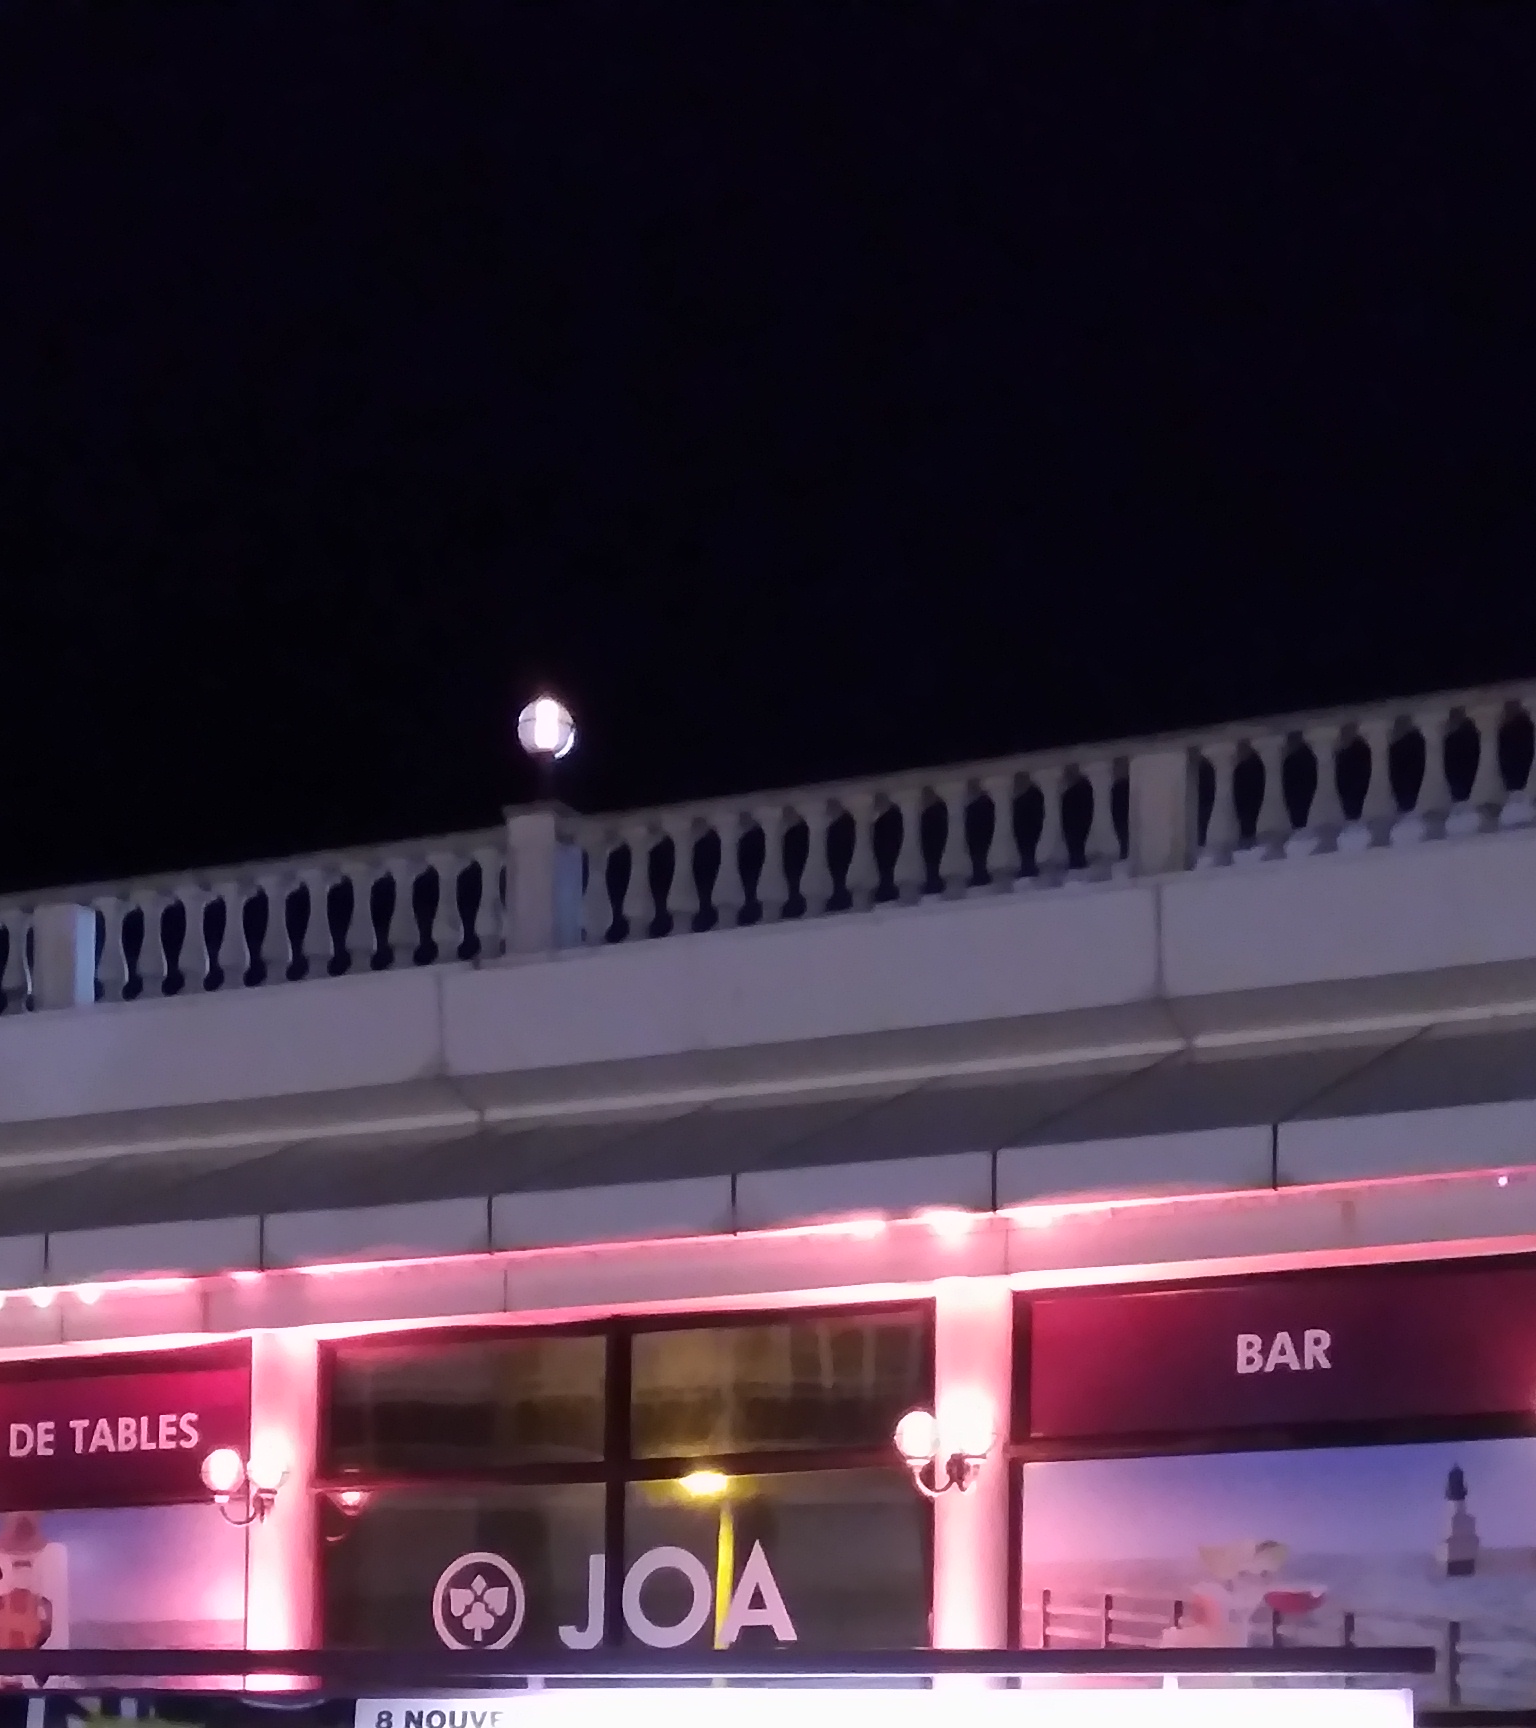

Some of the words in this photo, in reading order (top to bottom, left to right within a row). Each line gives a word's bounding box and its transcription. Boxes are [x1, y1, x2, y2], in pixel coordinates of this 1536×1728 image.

[1235, 1328, 1333, 1375] BAR
[9, 1421, 55, 1458] DE
[69, 1412, 201, 1455] TABLES
[557, 1538, 799, 1650] JOA
